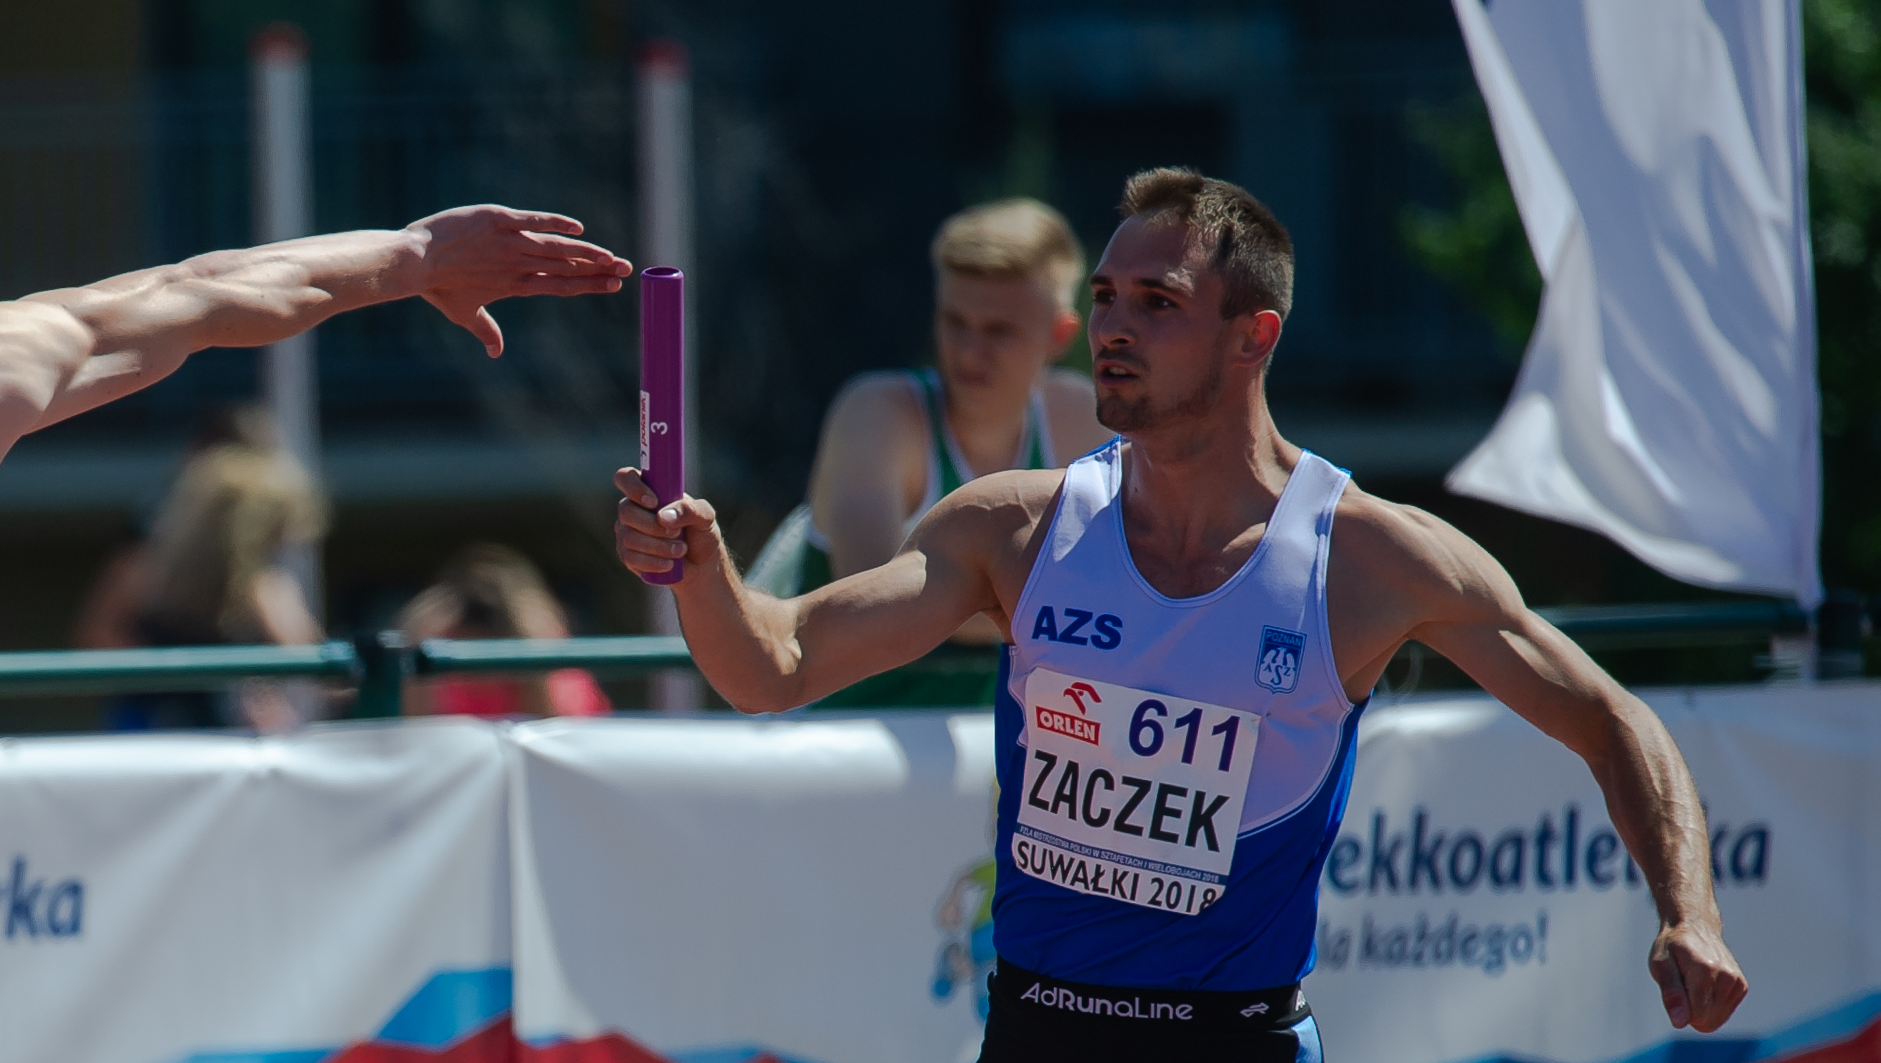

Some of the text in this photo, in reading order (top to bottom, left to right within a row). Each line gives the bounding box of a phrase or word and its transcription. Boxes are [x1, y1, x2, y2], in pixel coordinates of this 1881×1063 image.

[651, 422, 668, 435] 3
[1031, 605, 1124, 651] AZS
[1038, 712, 1097, 742] ORLEN
[1128, 698, 1241, 773] 611
[1027, 749, 1231, 853] ZACZEK
[1017, 839, 1217, 913] SUWAŁKI 2018
